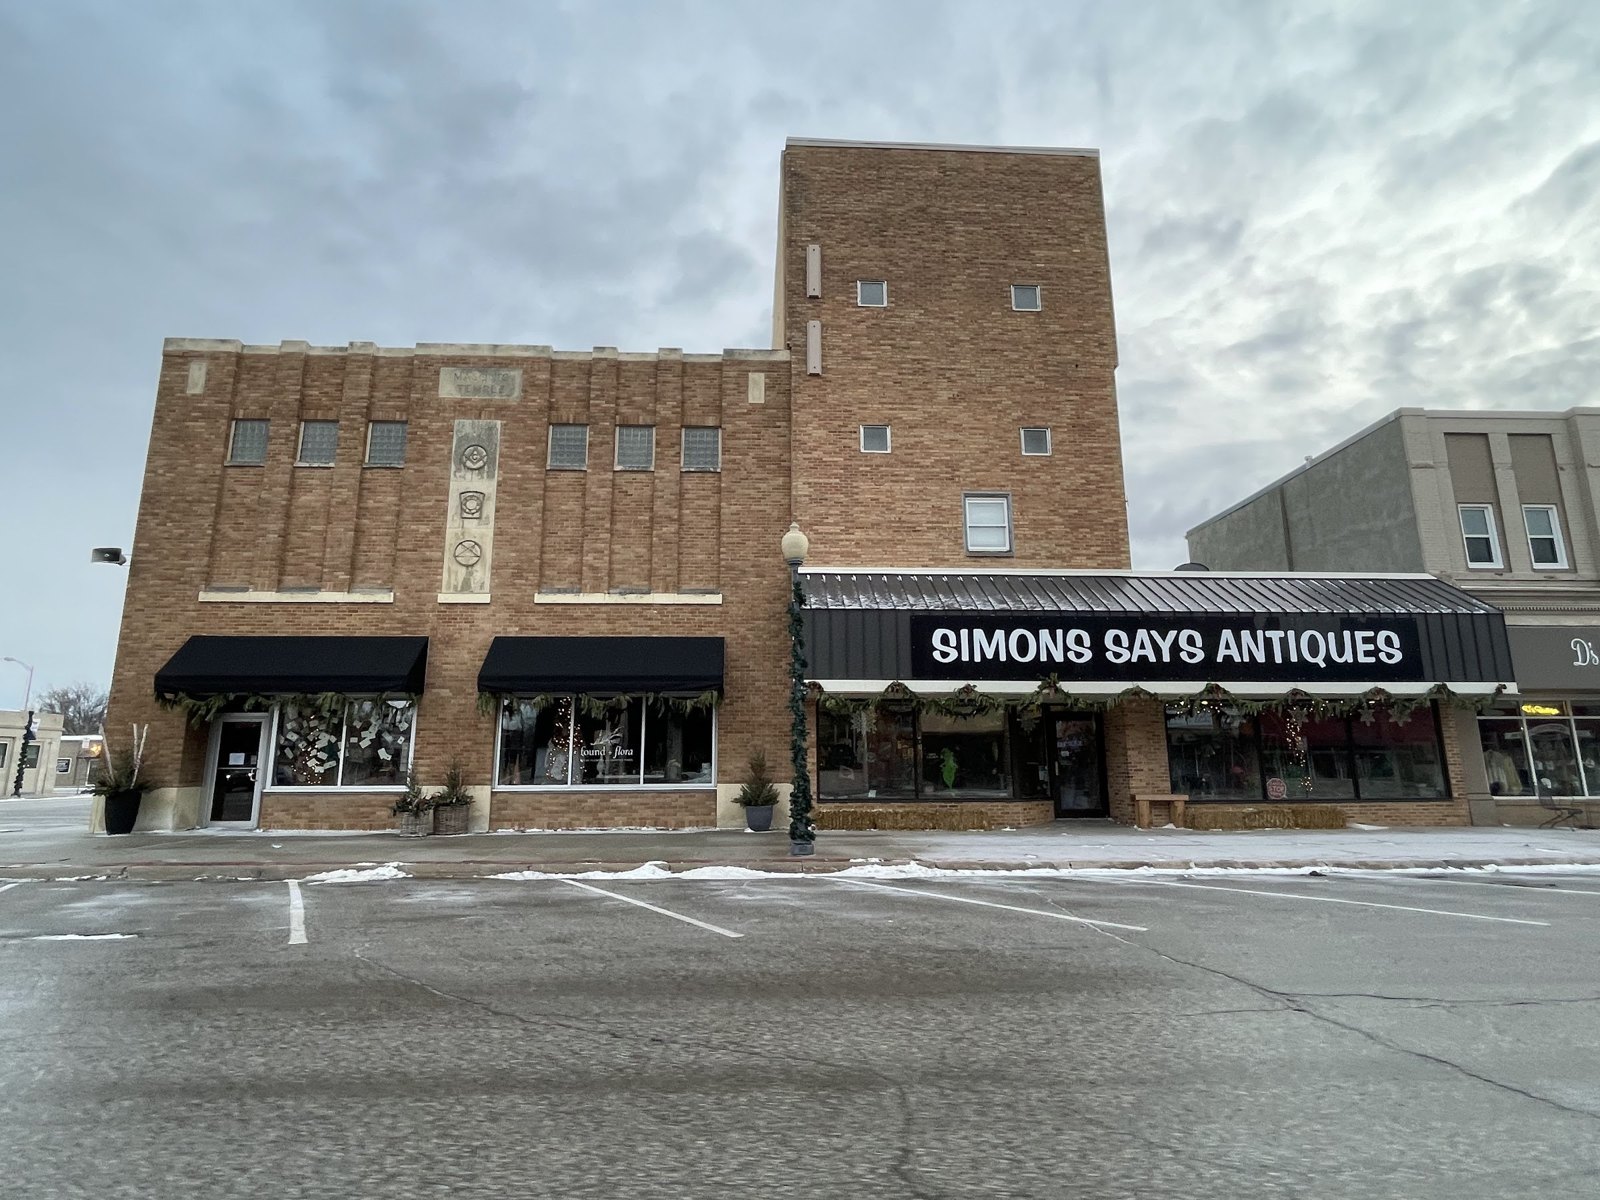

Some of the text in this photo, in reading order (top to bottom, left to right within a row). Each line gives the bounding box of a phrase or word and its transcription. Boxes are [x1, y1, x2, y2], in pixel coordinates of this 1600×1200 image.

[931, 628, 1403, 669] SIMONS SAYS ANTIQUES
[1571, 638, 1599, 666] D's
[580, 746, 606, 757] found
[612, 745, 633, 758] flora
